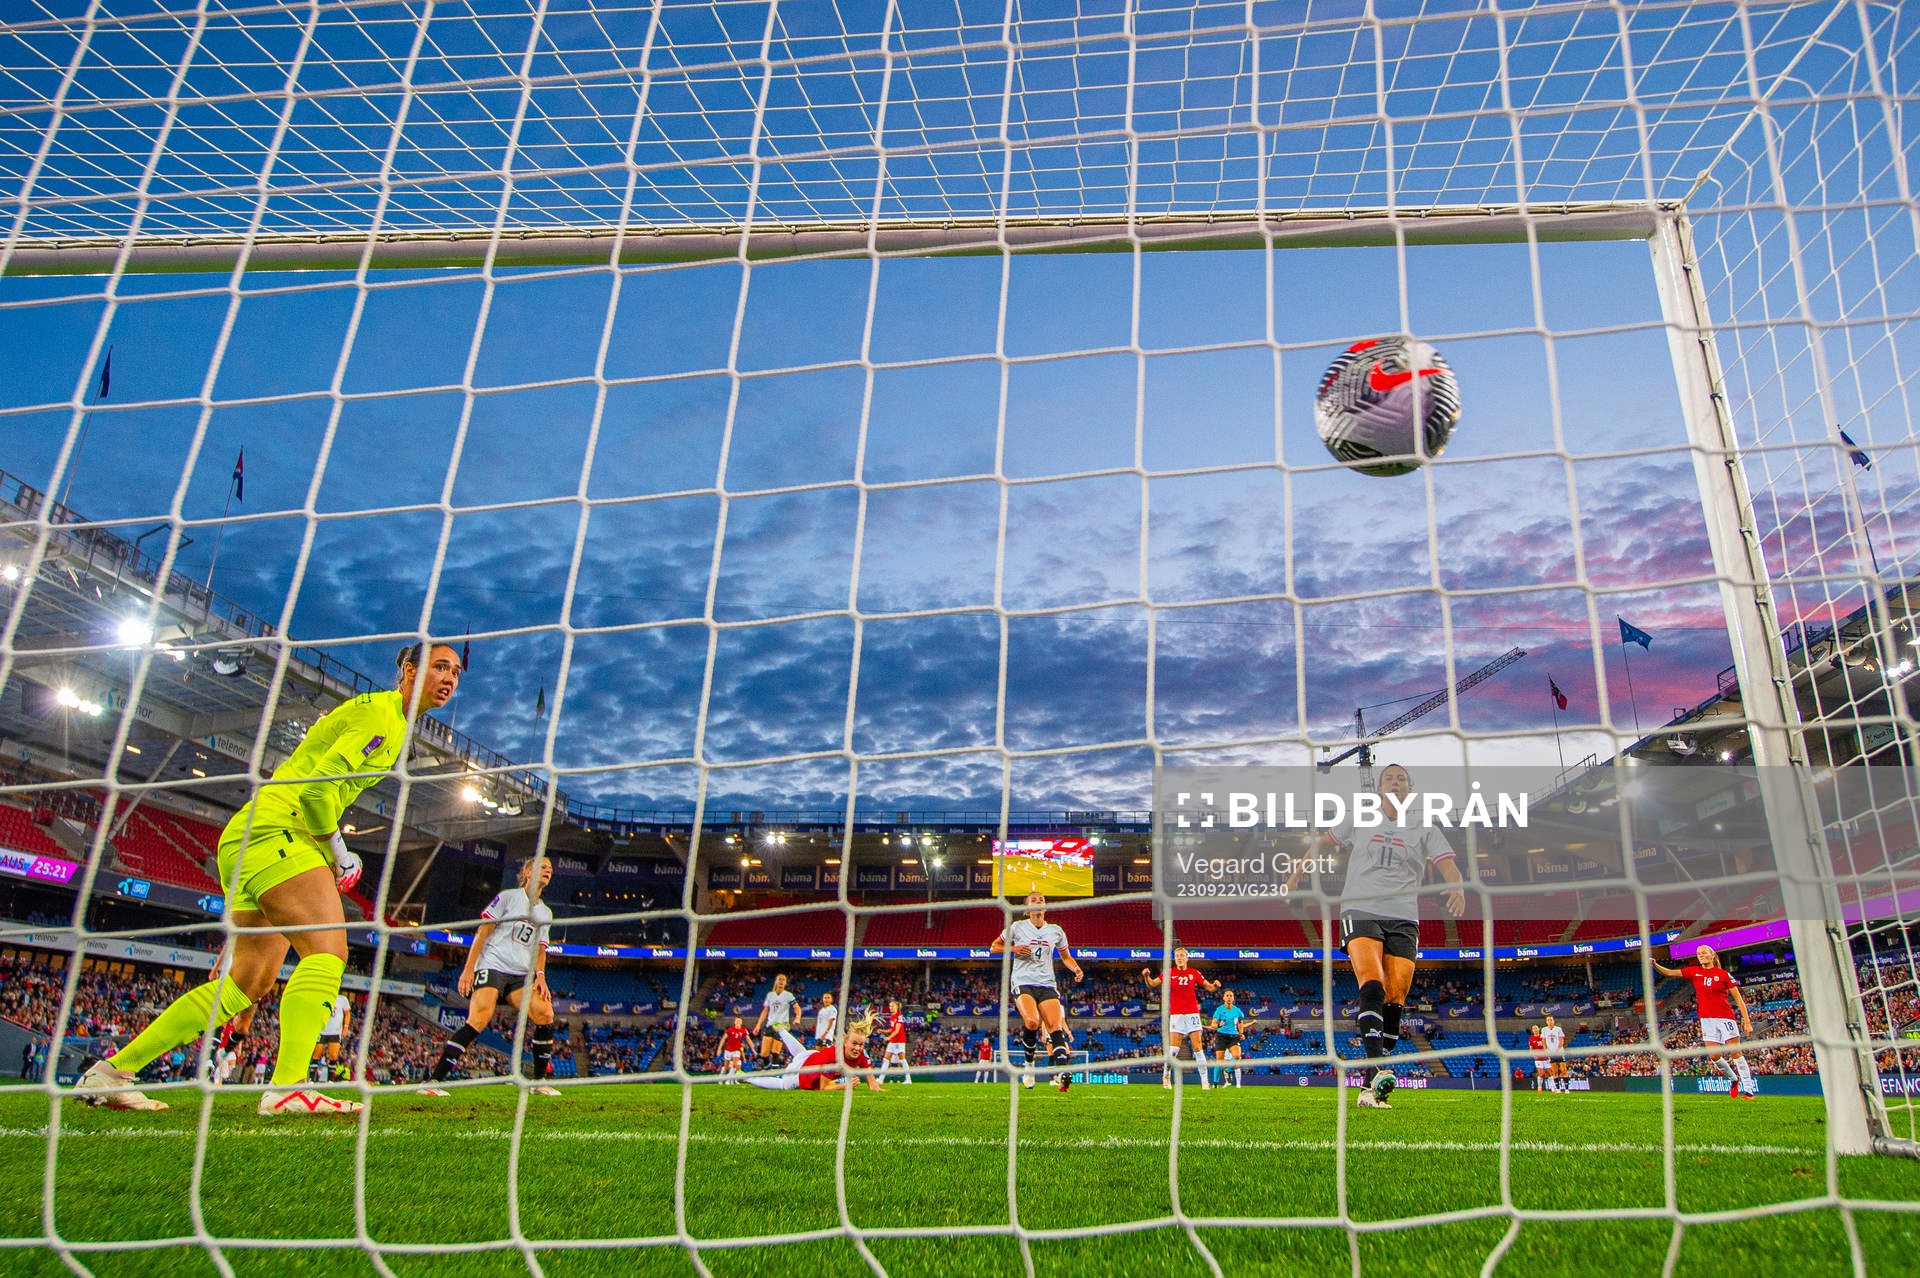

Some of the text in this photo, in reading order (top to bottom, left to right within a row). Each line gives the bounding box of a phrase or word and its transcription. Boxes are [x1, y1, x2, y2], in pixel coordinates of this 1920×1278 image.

[116, 694, 152, 719] tenor
[217, 736, 248, 759] telenor
[1381, 846, 1393, 866] 11
[35, 861, 67, 879] 25:21
[517, 924, 534, 943] 13
[1034, 947, 1042, 960] 4
[1179, 976, 1188, 985] 22
[1703, 977, 1712, 986] 18
[1725, 1021, 1734, 1031] 18
[1880, 1078, 1904, 1093] EFA
